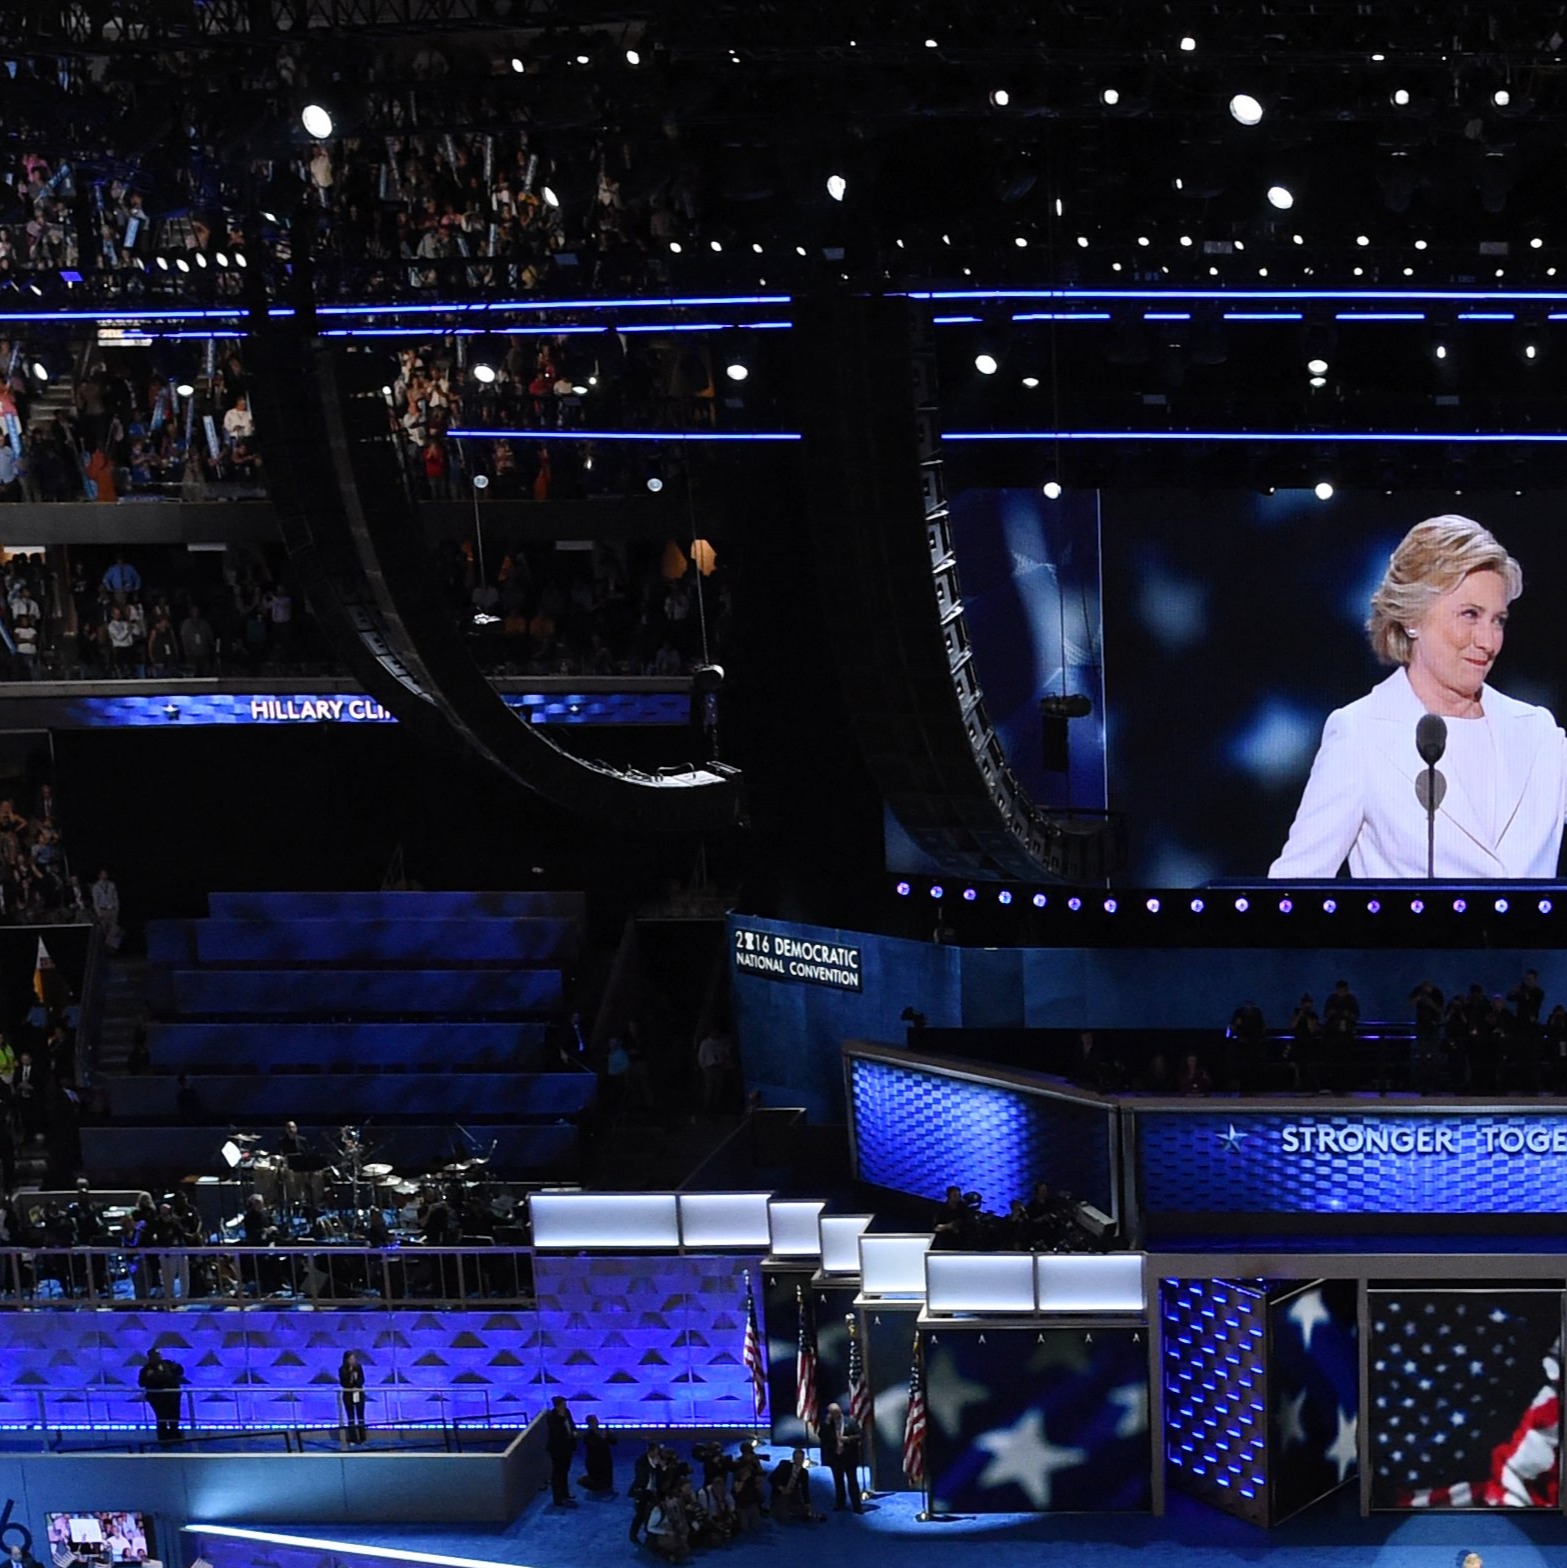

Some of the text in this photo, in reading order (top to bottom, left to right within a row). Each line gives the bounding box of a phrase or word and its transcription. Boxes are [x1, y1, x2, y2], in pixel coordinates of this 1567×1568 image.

[251, 701, 390, 719] HILLARY CLI
[775, 937, 859, 969] DEMOCRATIC
[736, 952, 859, 986] NATIONAL CONVENTION
[1281, 1126, 1455, 1153] STRONGER
